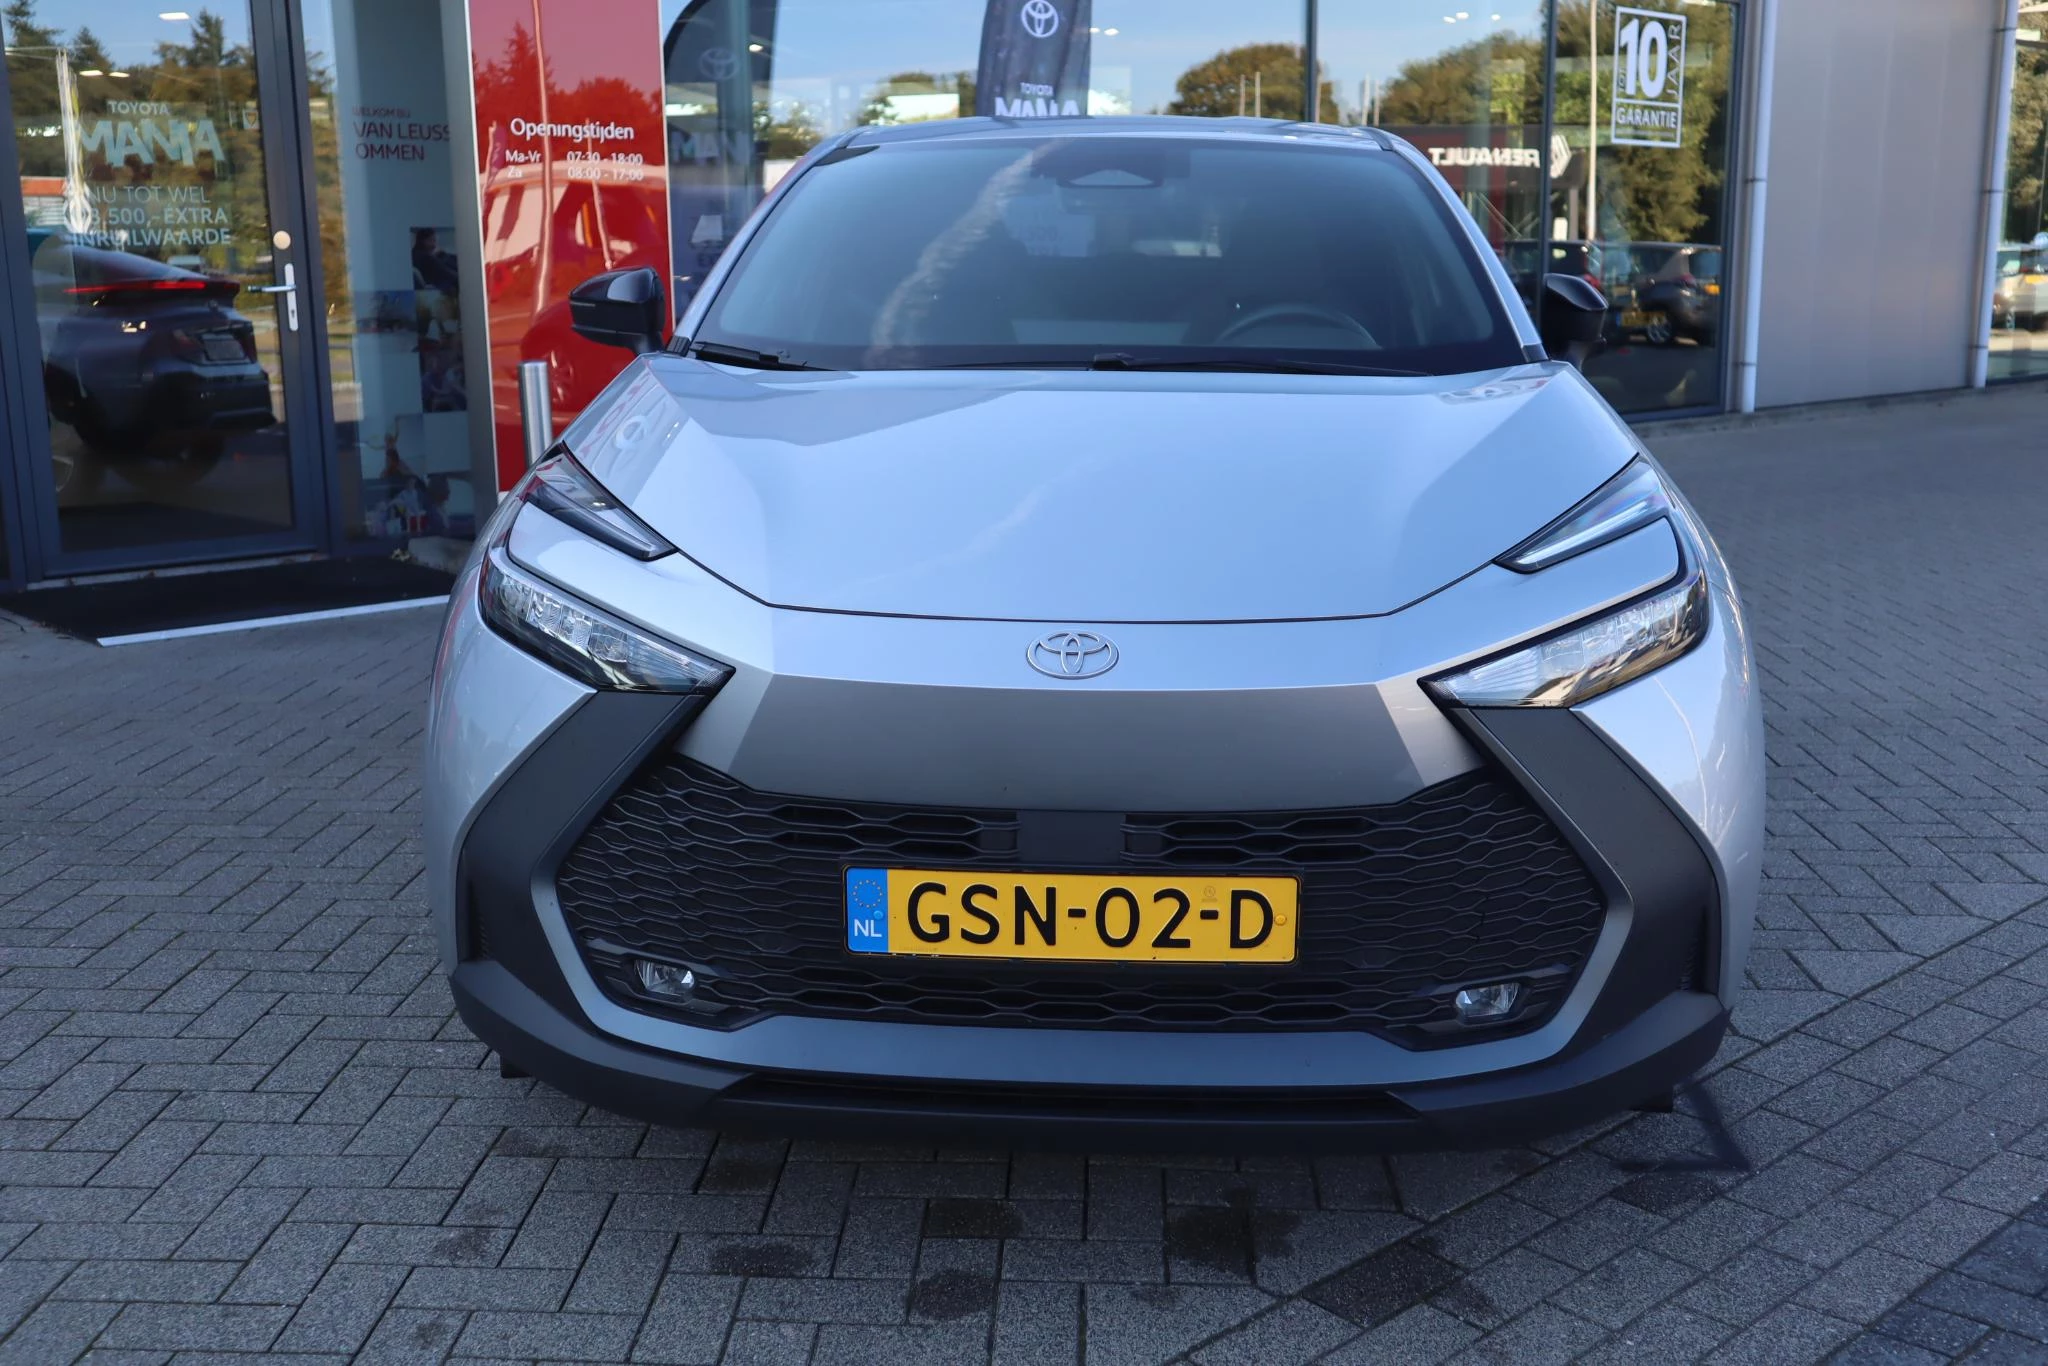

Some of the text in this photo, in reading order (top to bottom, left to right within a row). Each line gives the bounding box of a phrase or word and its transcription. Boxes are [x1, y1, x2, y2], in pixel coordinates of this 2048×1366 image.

[1620, 18, 1668, 99] 10
[1666, 24, 1681, 100] JAAR
[107, 100, 171, 115] TOYOTA
[1617, 107, 1677, 129] GARANTIE
[353, 121, 393, 139] VAN
[510, 117, 635, 144] Openingstijden
[78, 119, 225, 168] MANIA
[355, 143, 425, 160] OMMEN
[505, 149, 542, 164] Ma-Vr
[566, 151, 601, 166] 07:30
[611, 152, 644, 167] 18:00
[507, 164, 523, 179] Za
[567, 166, 601, 181] 08:00
[612, 168, 645, 182] 17:00
[124, 185, 162, 203] TOT
[167, 186, 212, 204] WEL
[163, 207, 229, 225] EXTRA
[73, 227, 232, 248] INRUILWAARDE
[853, 881, 1274, 949] NL GSN-02-D
